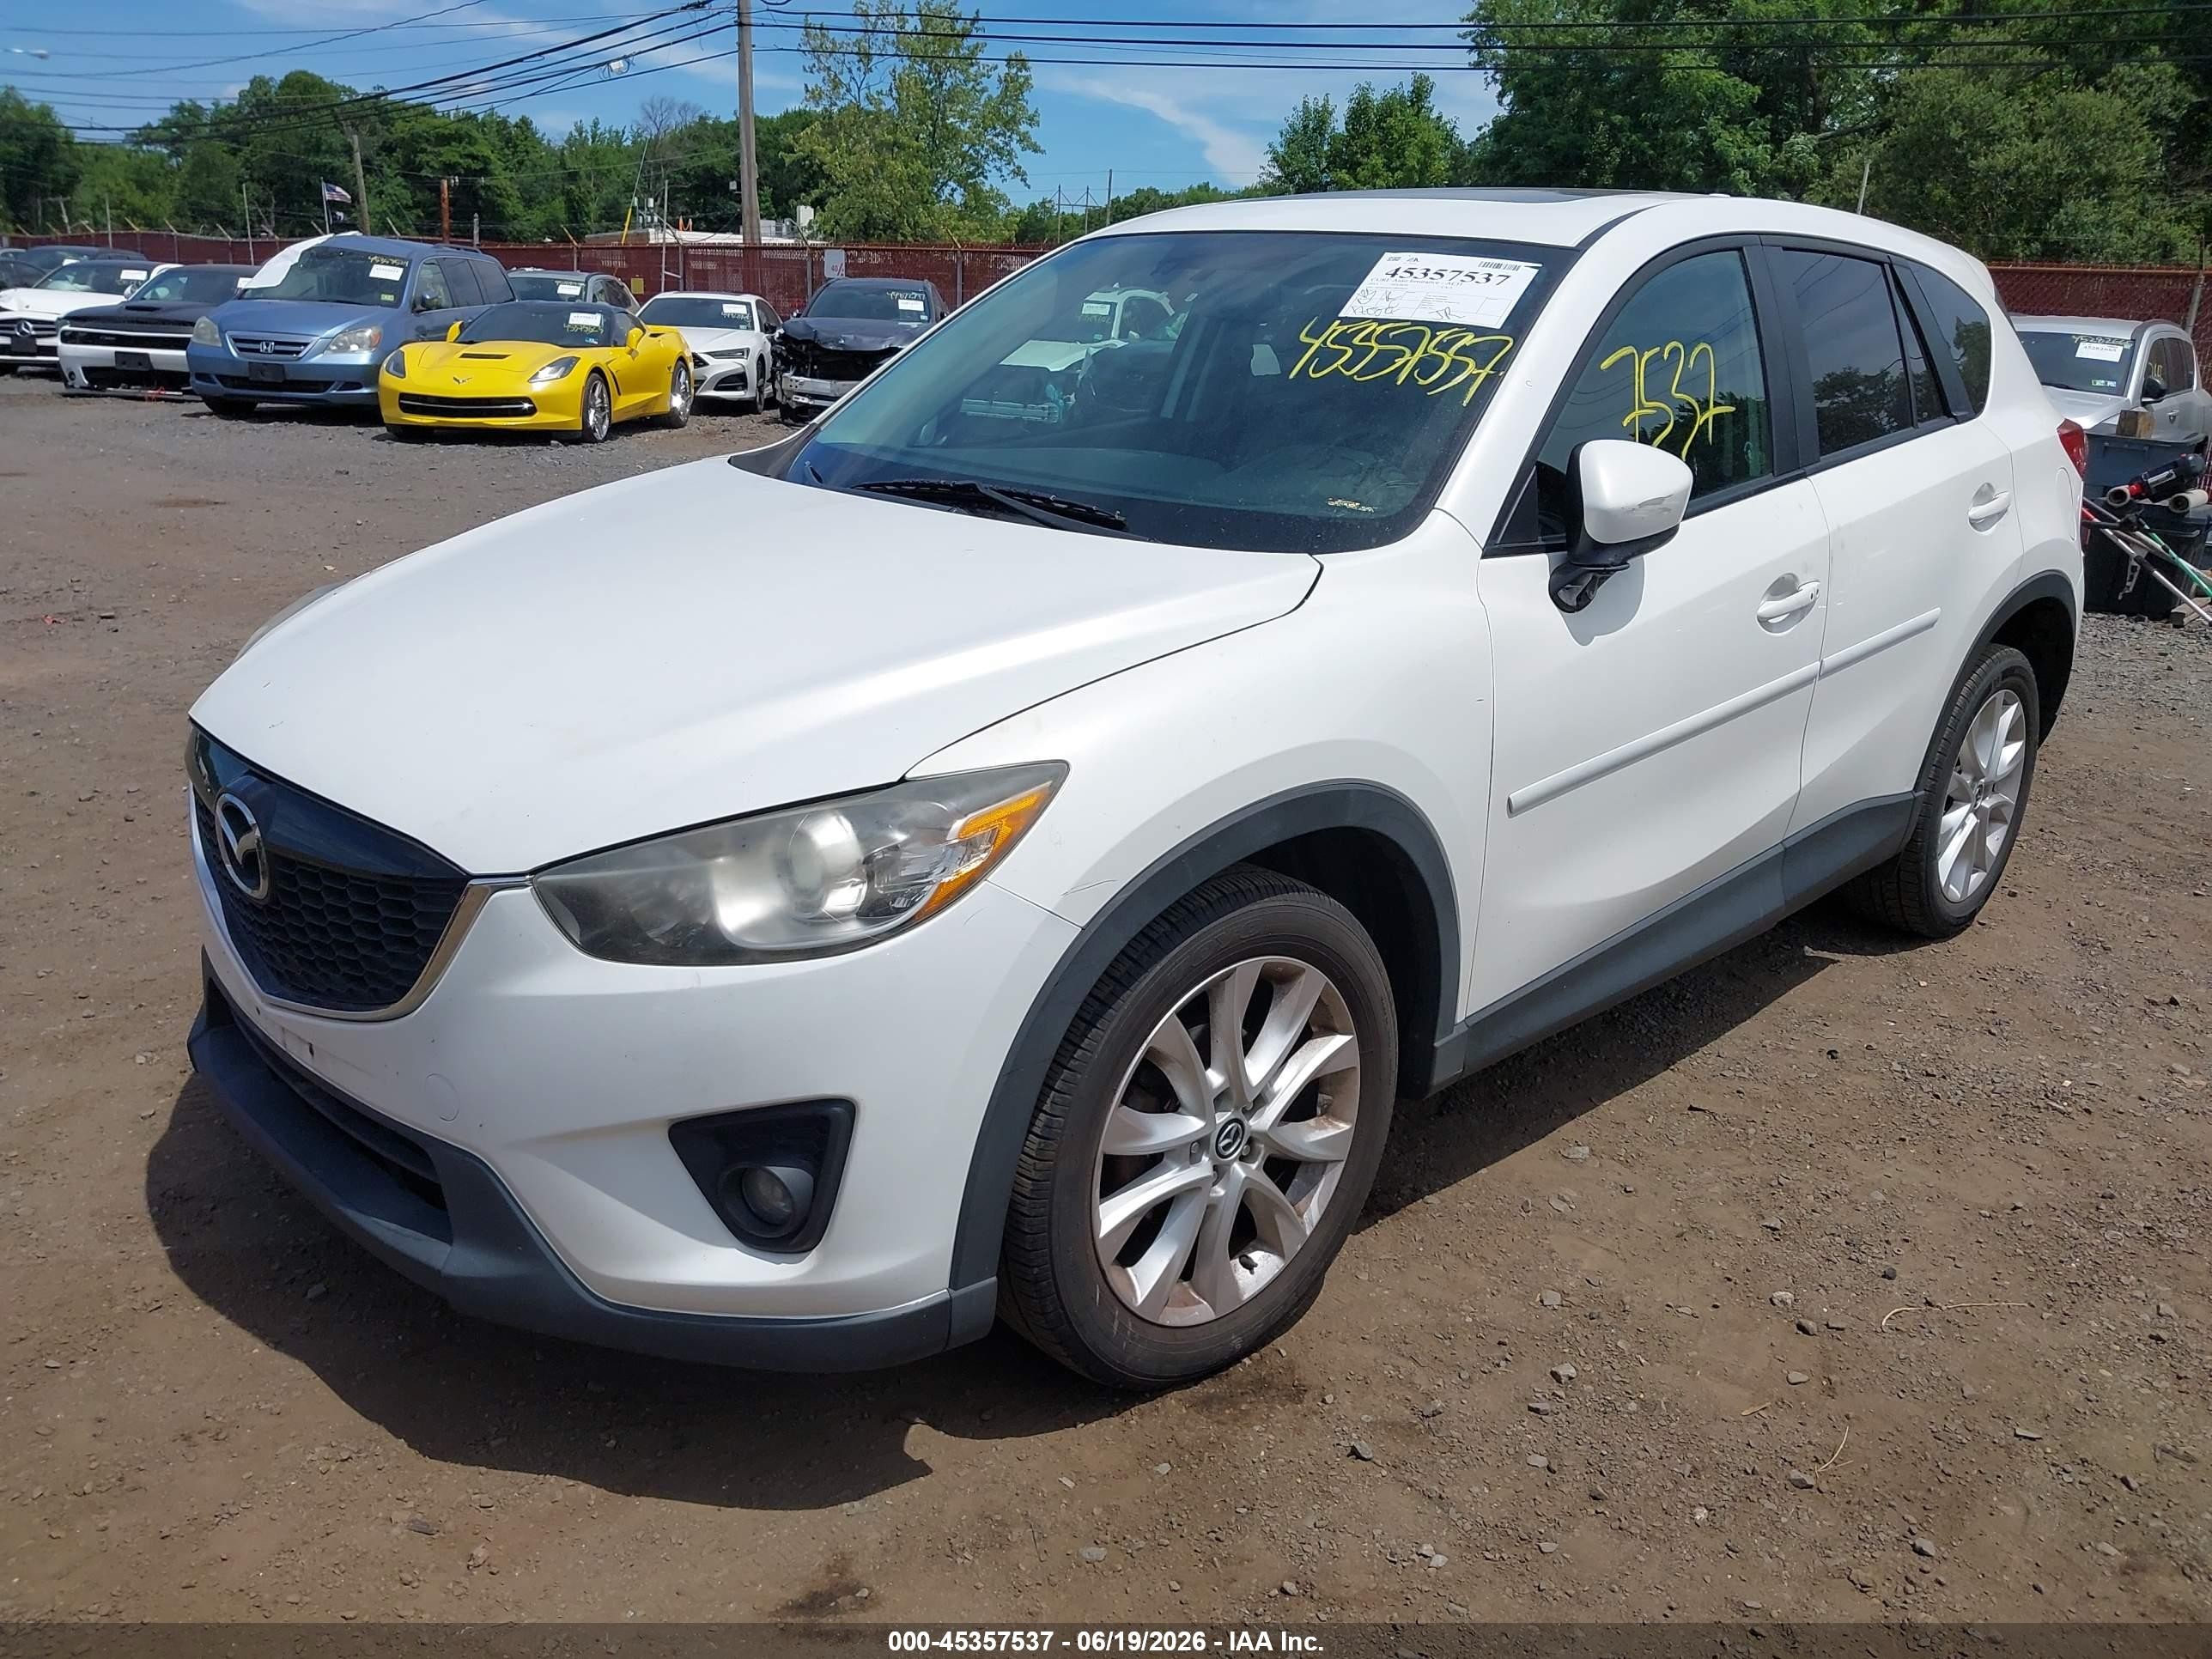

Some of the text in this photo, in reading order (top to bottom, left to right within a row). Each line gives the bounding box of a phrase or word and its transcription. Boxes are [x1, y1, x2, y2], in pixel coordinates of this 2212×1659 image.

[1385, 266, 1511, 286] 45357537
[1288, 315, 1514, 407] 45357537
[1600, 340, 1737, 462] 7537
